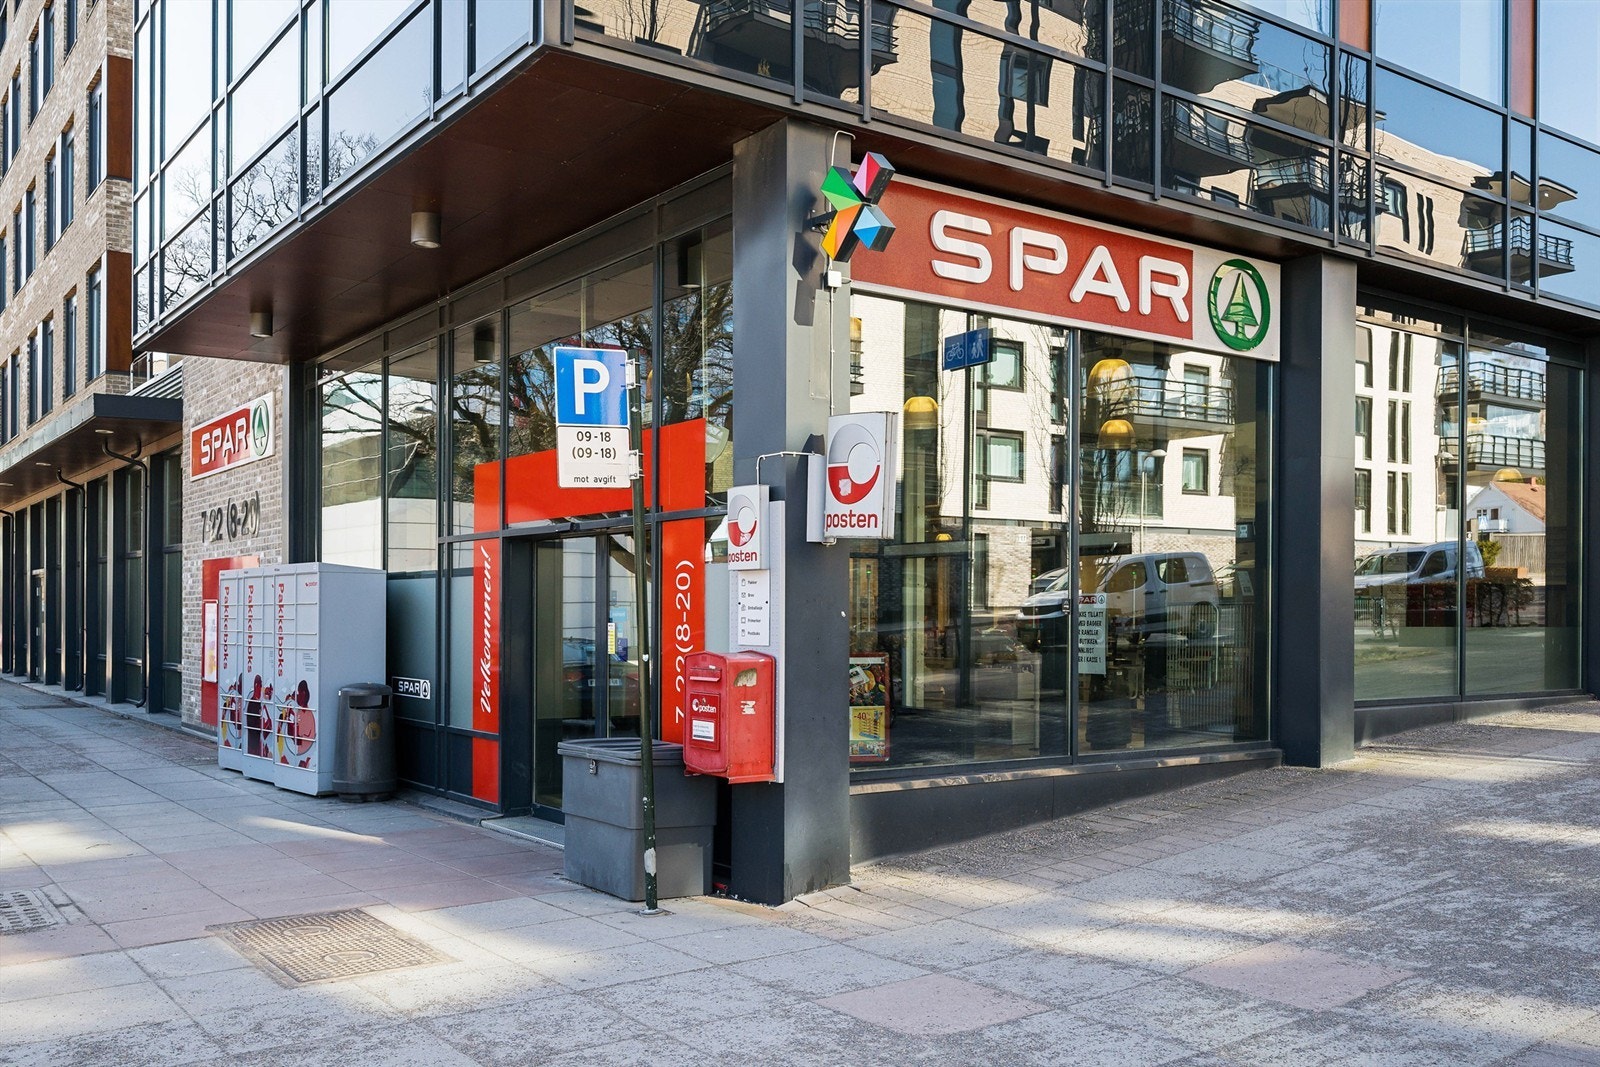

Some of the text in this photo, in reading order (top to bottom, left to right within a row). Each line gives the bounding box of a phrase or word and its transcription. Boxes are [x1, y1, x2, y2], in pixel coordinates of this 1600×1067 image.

[930, 209, 1190, 322] SPAR
[573, 359, 610, 415] P
[201, 416, 248, 465] SPAR
[573, 475, 617, 485] mot avgift
[826, 509, 878, 532] posten
[1079, 596, 1097, 604] PAR
[479, 545, 493, 714] Velkommen!
[398, 681, 421, 694] SPAR
[699, 704, 717, 714] posten
